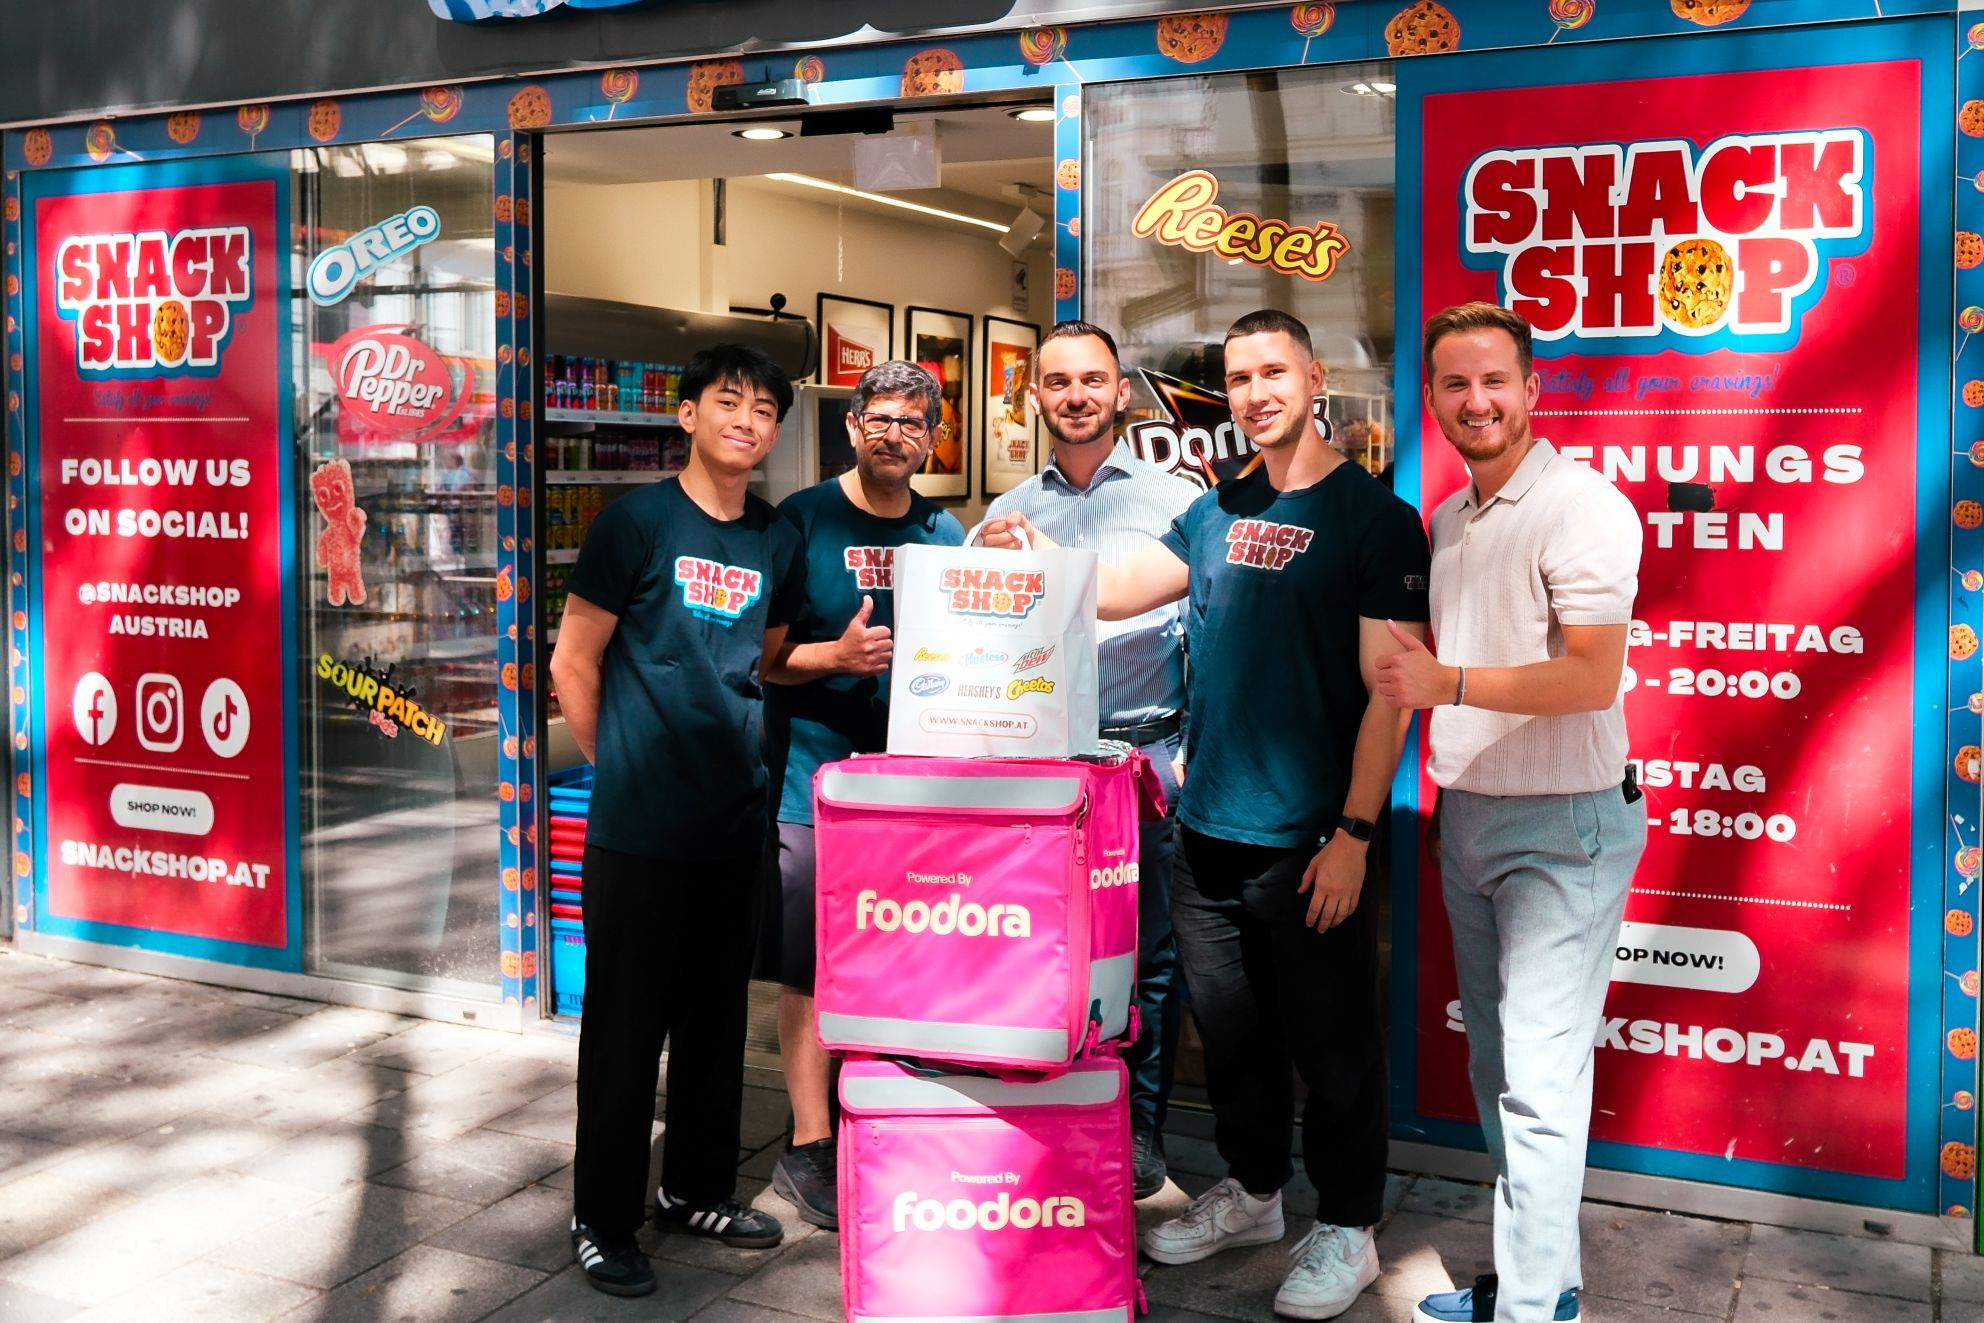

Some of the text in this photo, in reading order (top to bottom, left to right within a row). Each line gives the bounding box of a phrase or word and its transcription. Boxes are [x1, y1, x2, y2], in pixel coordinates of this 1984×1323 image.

[1473, 140, 1853, 244] SNACK
[1135, 176, 1343, 275] Reese's
[63, 233, 245, 301] SNACK
[312, 209, 436, 297] OREO
[1511, 237, 1809, 331] SHOP
[82, 300, 224, 362] SHOP
[380, 343, 425, 382] Dr
[841, 348, 871, 368] HERR'S
[341, 339, 443, 415] Pepper
[1604, 366, 1630, 392] all
[1636, 375, 1681, 400] your
[61, 457, 251, 487] FOLLOW US
[64, 507, 249, 540] ON SOCIAL!
[1229, 522, 1310, 550] SNACK
[1647, 512, 1784, 551] TEN
[848, 549, 895, 568] SNA
[678, 558, 758, 593] SNACK
[859, 568, 894, 588] SH
[944, 568, 1043, 593] SNACK
[78, 582, 241, 608] @SNACKSHOP
[952, 590, 1033, 613] SHOP
[109, 614, 209, 639] AUSTRIA
[1627, 620, 1864, 654] G-FREITAG
[317, 654, 447, 746] SOUR PATCH
[957, 684, 1002, 699] HERSHEY'S
[1007, 676, 1055, 700] Cheetos
[1667, 668, 1802, 699] 20:00
[928, 714, 1029, 731] WWW.SNACKSHOP.AT
[127, 800, 197, 819] SHOP NOW!
[1669, 808, 1797, 842] 18:00
[60, 840, 271, 889] SNACKSHOP.AT
[906, 872, 972, 887] Powered By
[856, 889, 1031, 938] foodora
[1615, 947, 1724, 971] OP NOW!
[951, 1171, 1020, 1186] Powered By
[893, 1191, 1085, 1232] foodora
